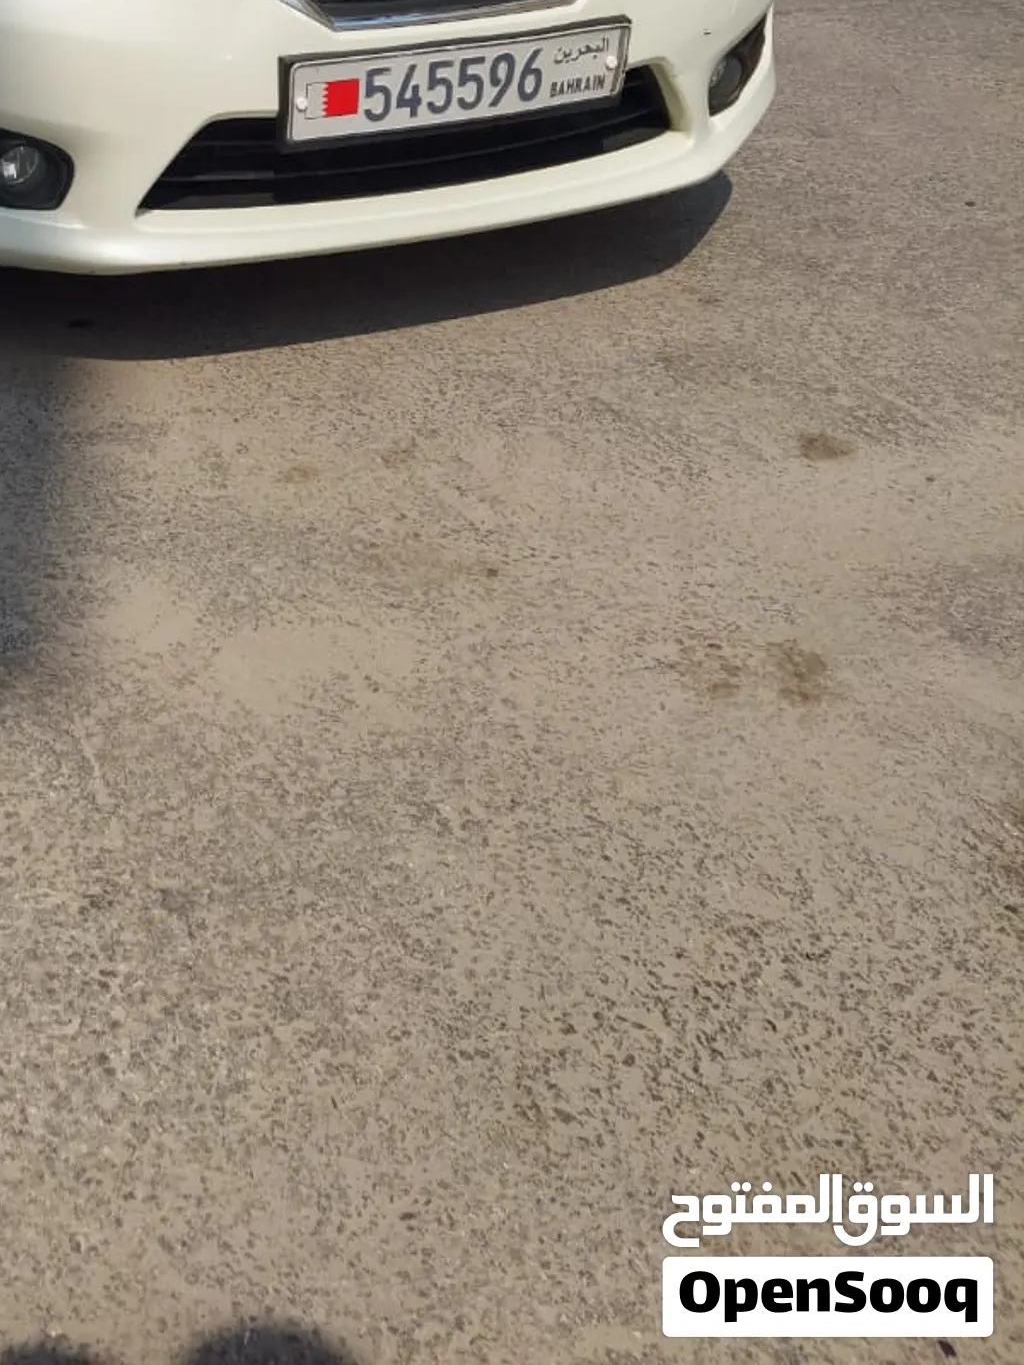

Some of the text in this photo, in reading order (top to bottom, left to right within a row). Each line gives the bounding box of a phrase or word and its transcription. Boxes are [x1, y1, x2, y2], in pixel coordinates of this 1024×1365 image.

[553, 37, 609, 65] البحرين
[363, 47, 543, 122] 545596
[549, 74, 606, 98] BAHRAIN
